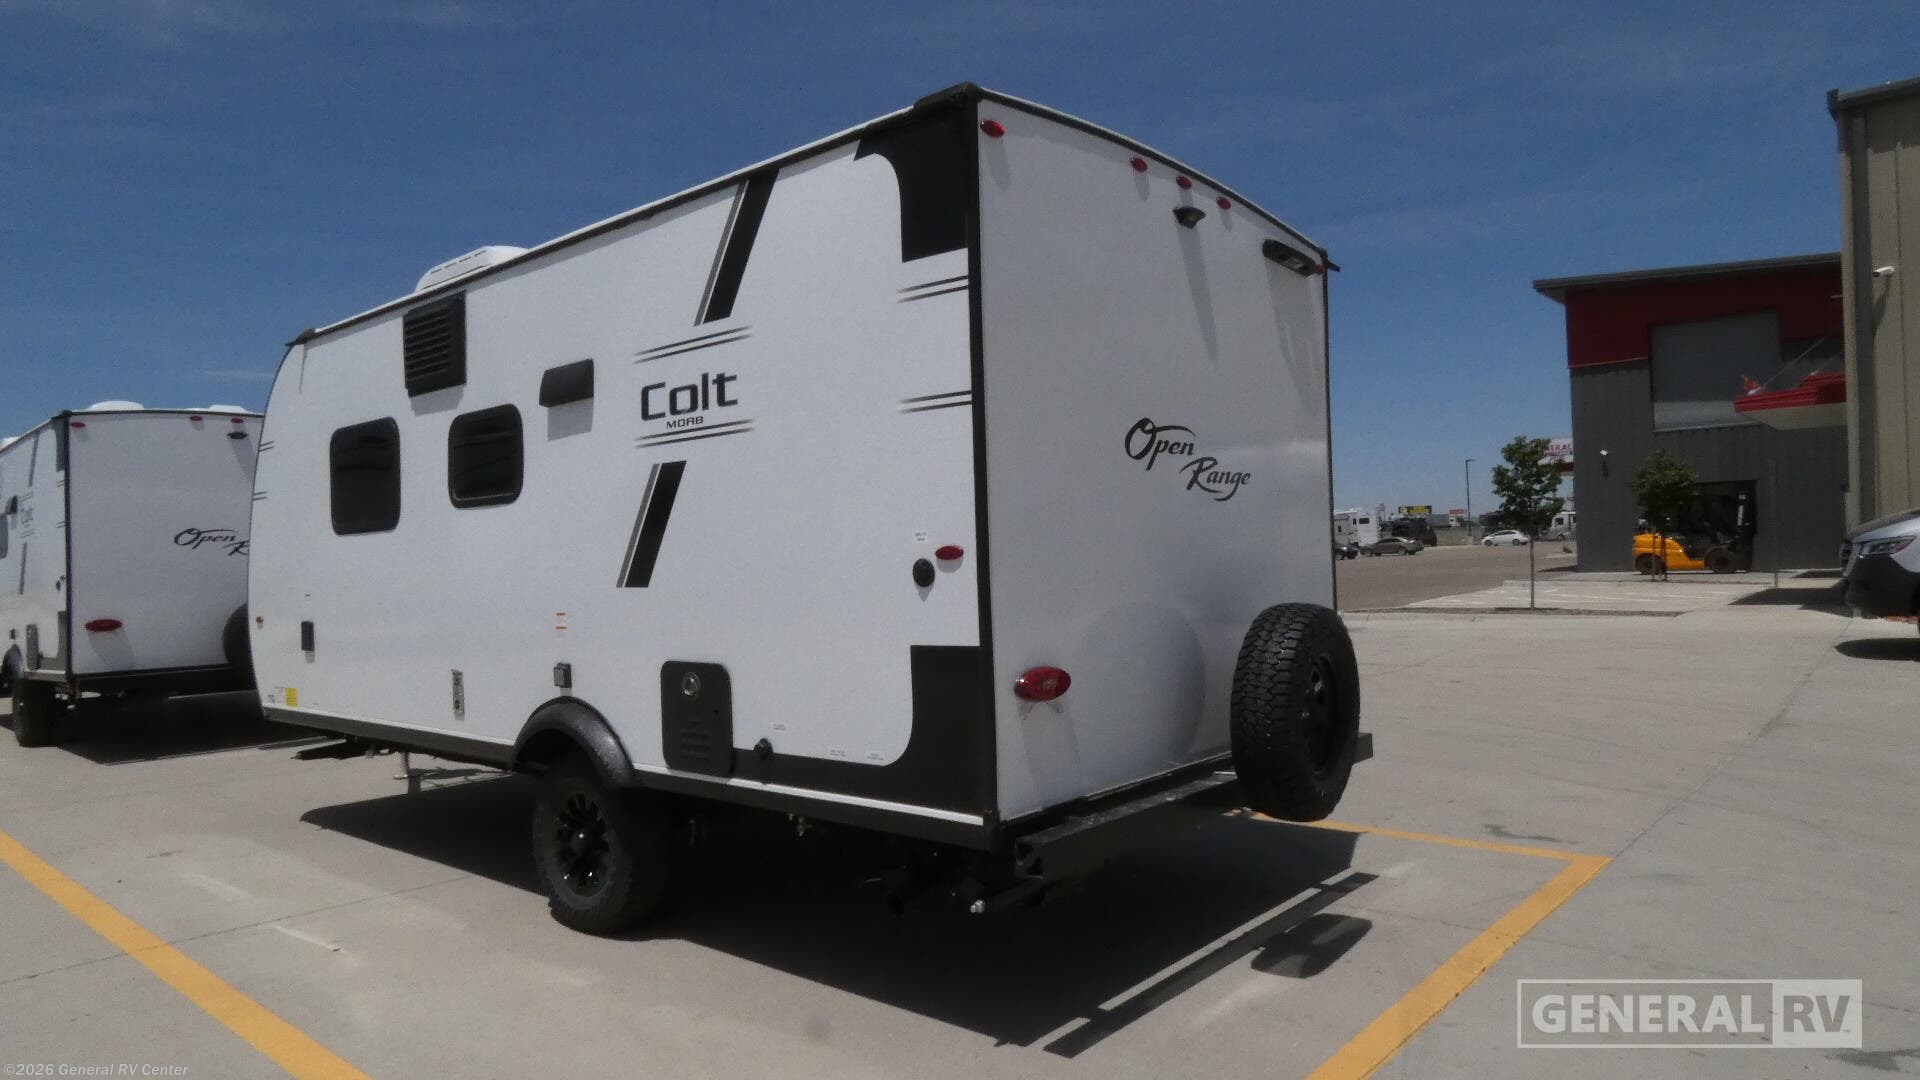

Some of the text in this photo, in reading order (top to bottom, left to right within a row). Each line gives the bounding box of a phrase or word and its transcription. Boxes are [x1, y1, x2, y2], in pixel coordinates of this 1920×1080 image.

[641, 372, 738, 421] Colt
[666, 416, 703, 429] MOAB
[1125, 417, 1197, 471] Open
[1179, 456, 1251, 501] Range
[174, 527, 239, 550] Open
